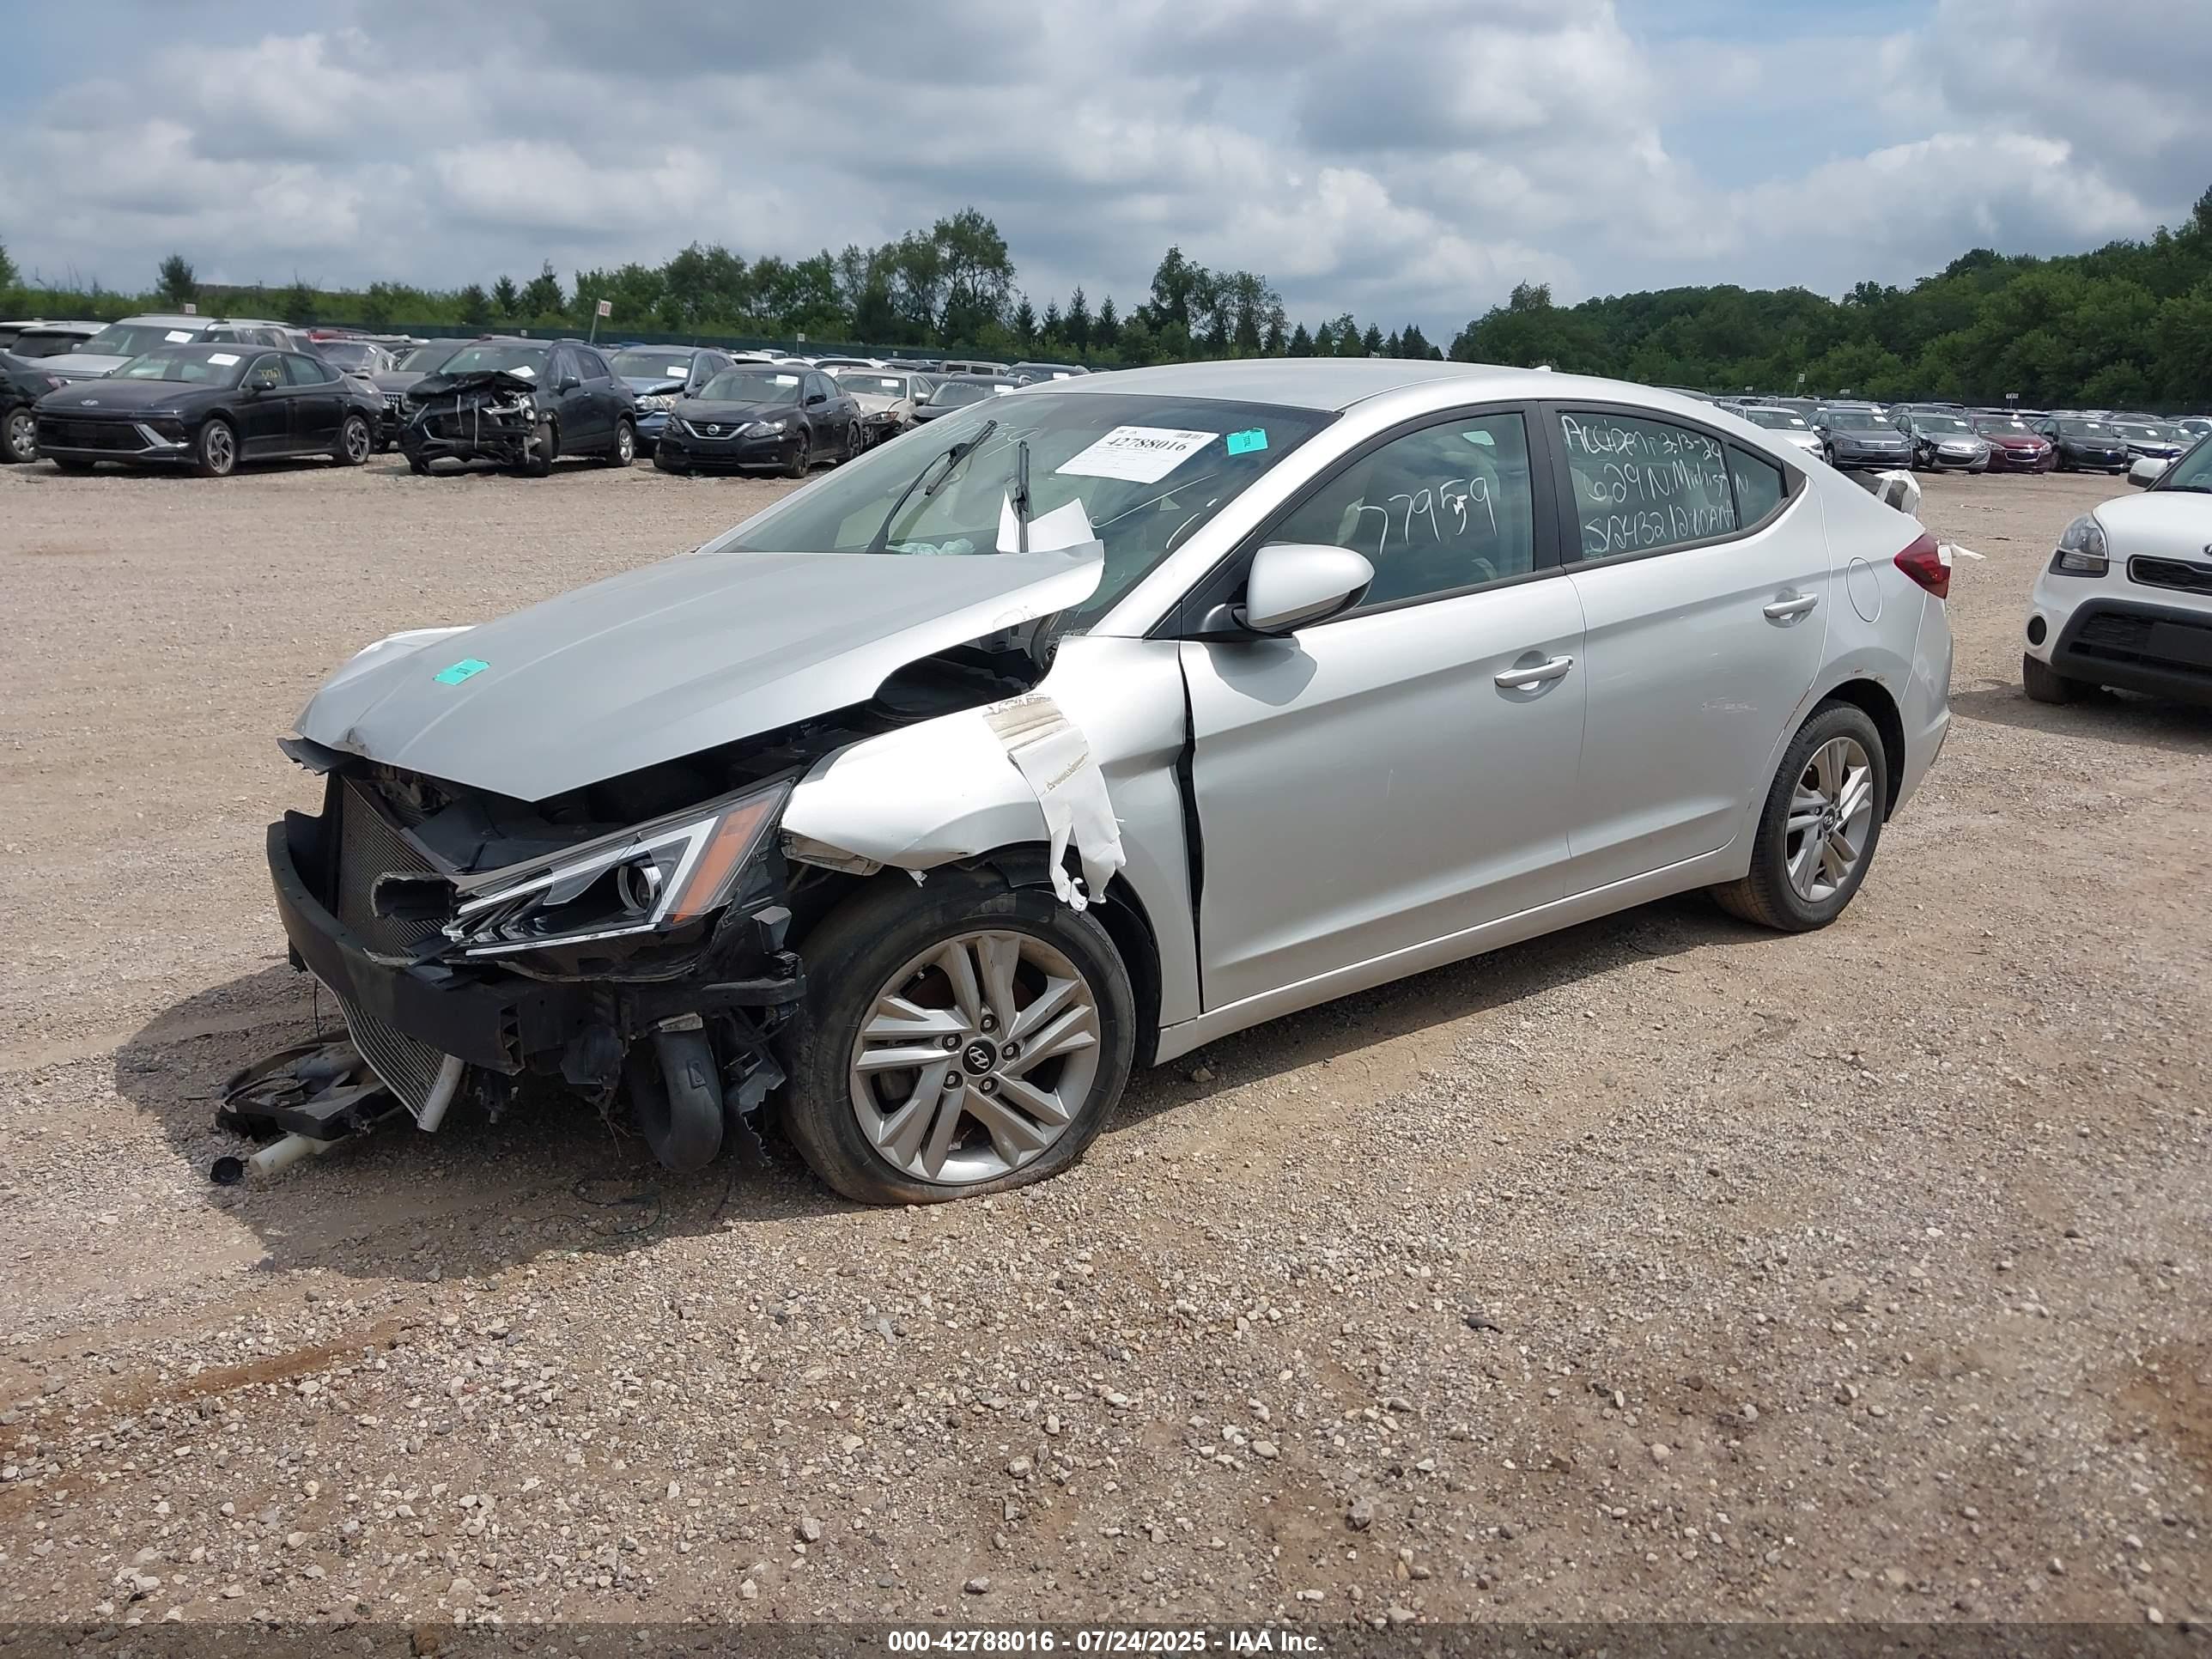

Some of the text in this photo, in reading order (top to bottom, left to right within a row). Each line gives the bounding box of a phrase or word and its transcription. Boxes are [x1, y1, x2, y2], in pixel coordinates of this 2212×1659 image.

[1106, 437, 1188, 452] 42788016
[1583, 463, 1645, 503] 629
[1356, 477, 1498, 556] 77959
